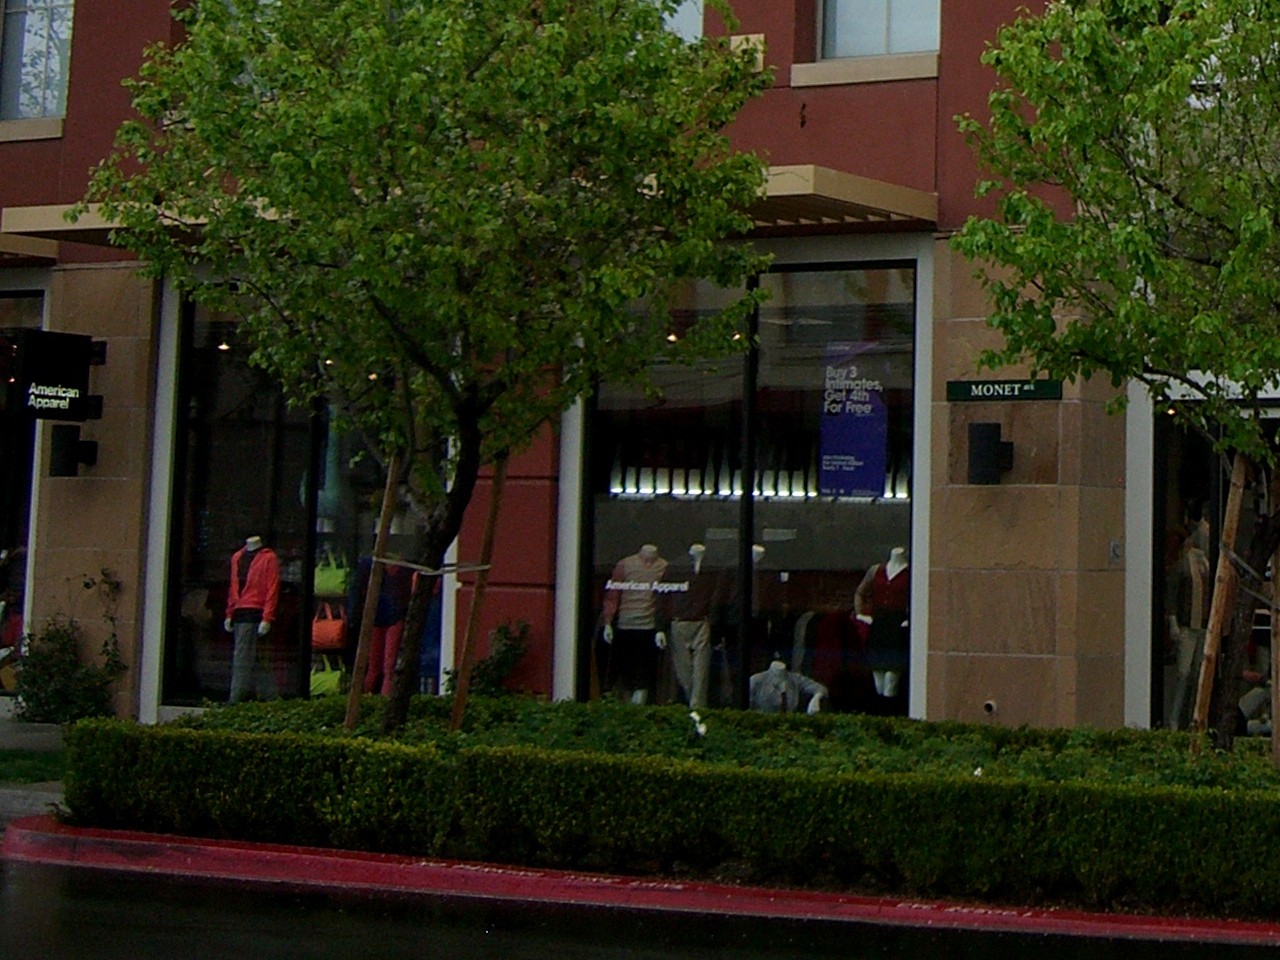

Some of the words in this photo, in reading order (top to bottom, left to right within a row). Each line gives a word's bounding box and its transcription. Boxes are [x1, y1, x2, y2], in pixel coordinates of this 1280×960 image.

[826, 366, 848, 381] Buy
[849, 366, 857, 378] 3
[28, 382, 79, 398] American
[825, 378, 883, 392] Intimates,
[970, 384, 1021, 396] MONET
[28, 394, 70, 410] Apparel
[824, 390, 846, 401] Get
[850, 390, 870, 401] 4th
[824, 401, 842, 413] For
[604, 579, 650, 591] American
[651, 581, 689, 593] Apparel
